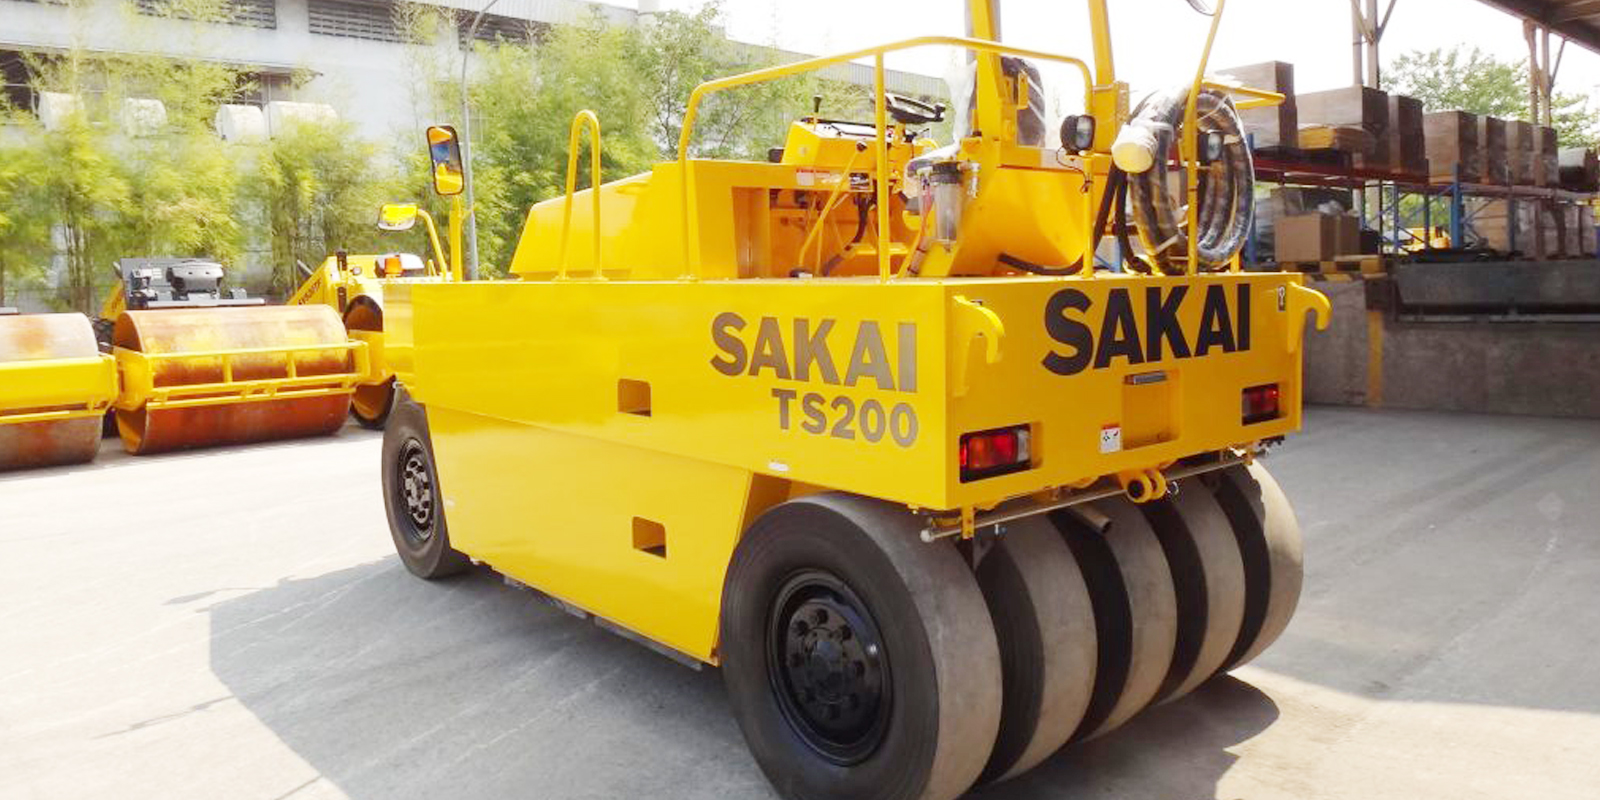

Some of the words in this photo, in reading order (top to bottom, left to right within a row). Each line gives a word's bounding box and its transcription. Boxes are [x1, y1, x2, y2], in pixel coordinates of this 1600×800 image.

[710, 312, 918, 393] SAKAI
[1042, 284, 1251, 376] SAKAI
[771, 388, 919, 448] TS200
